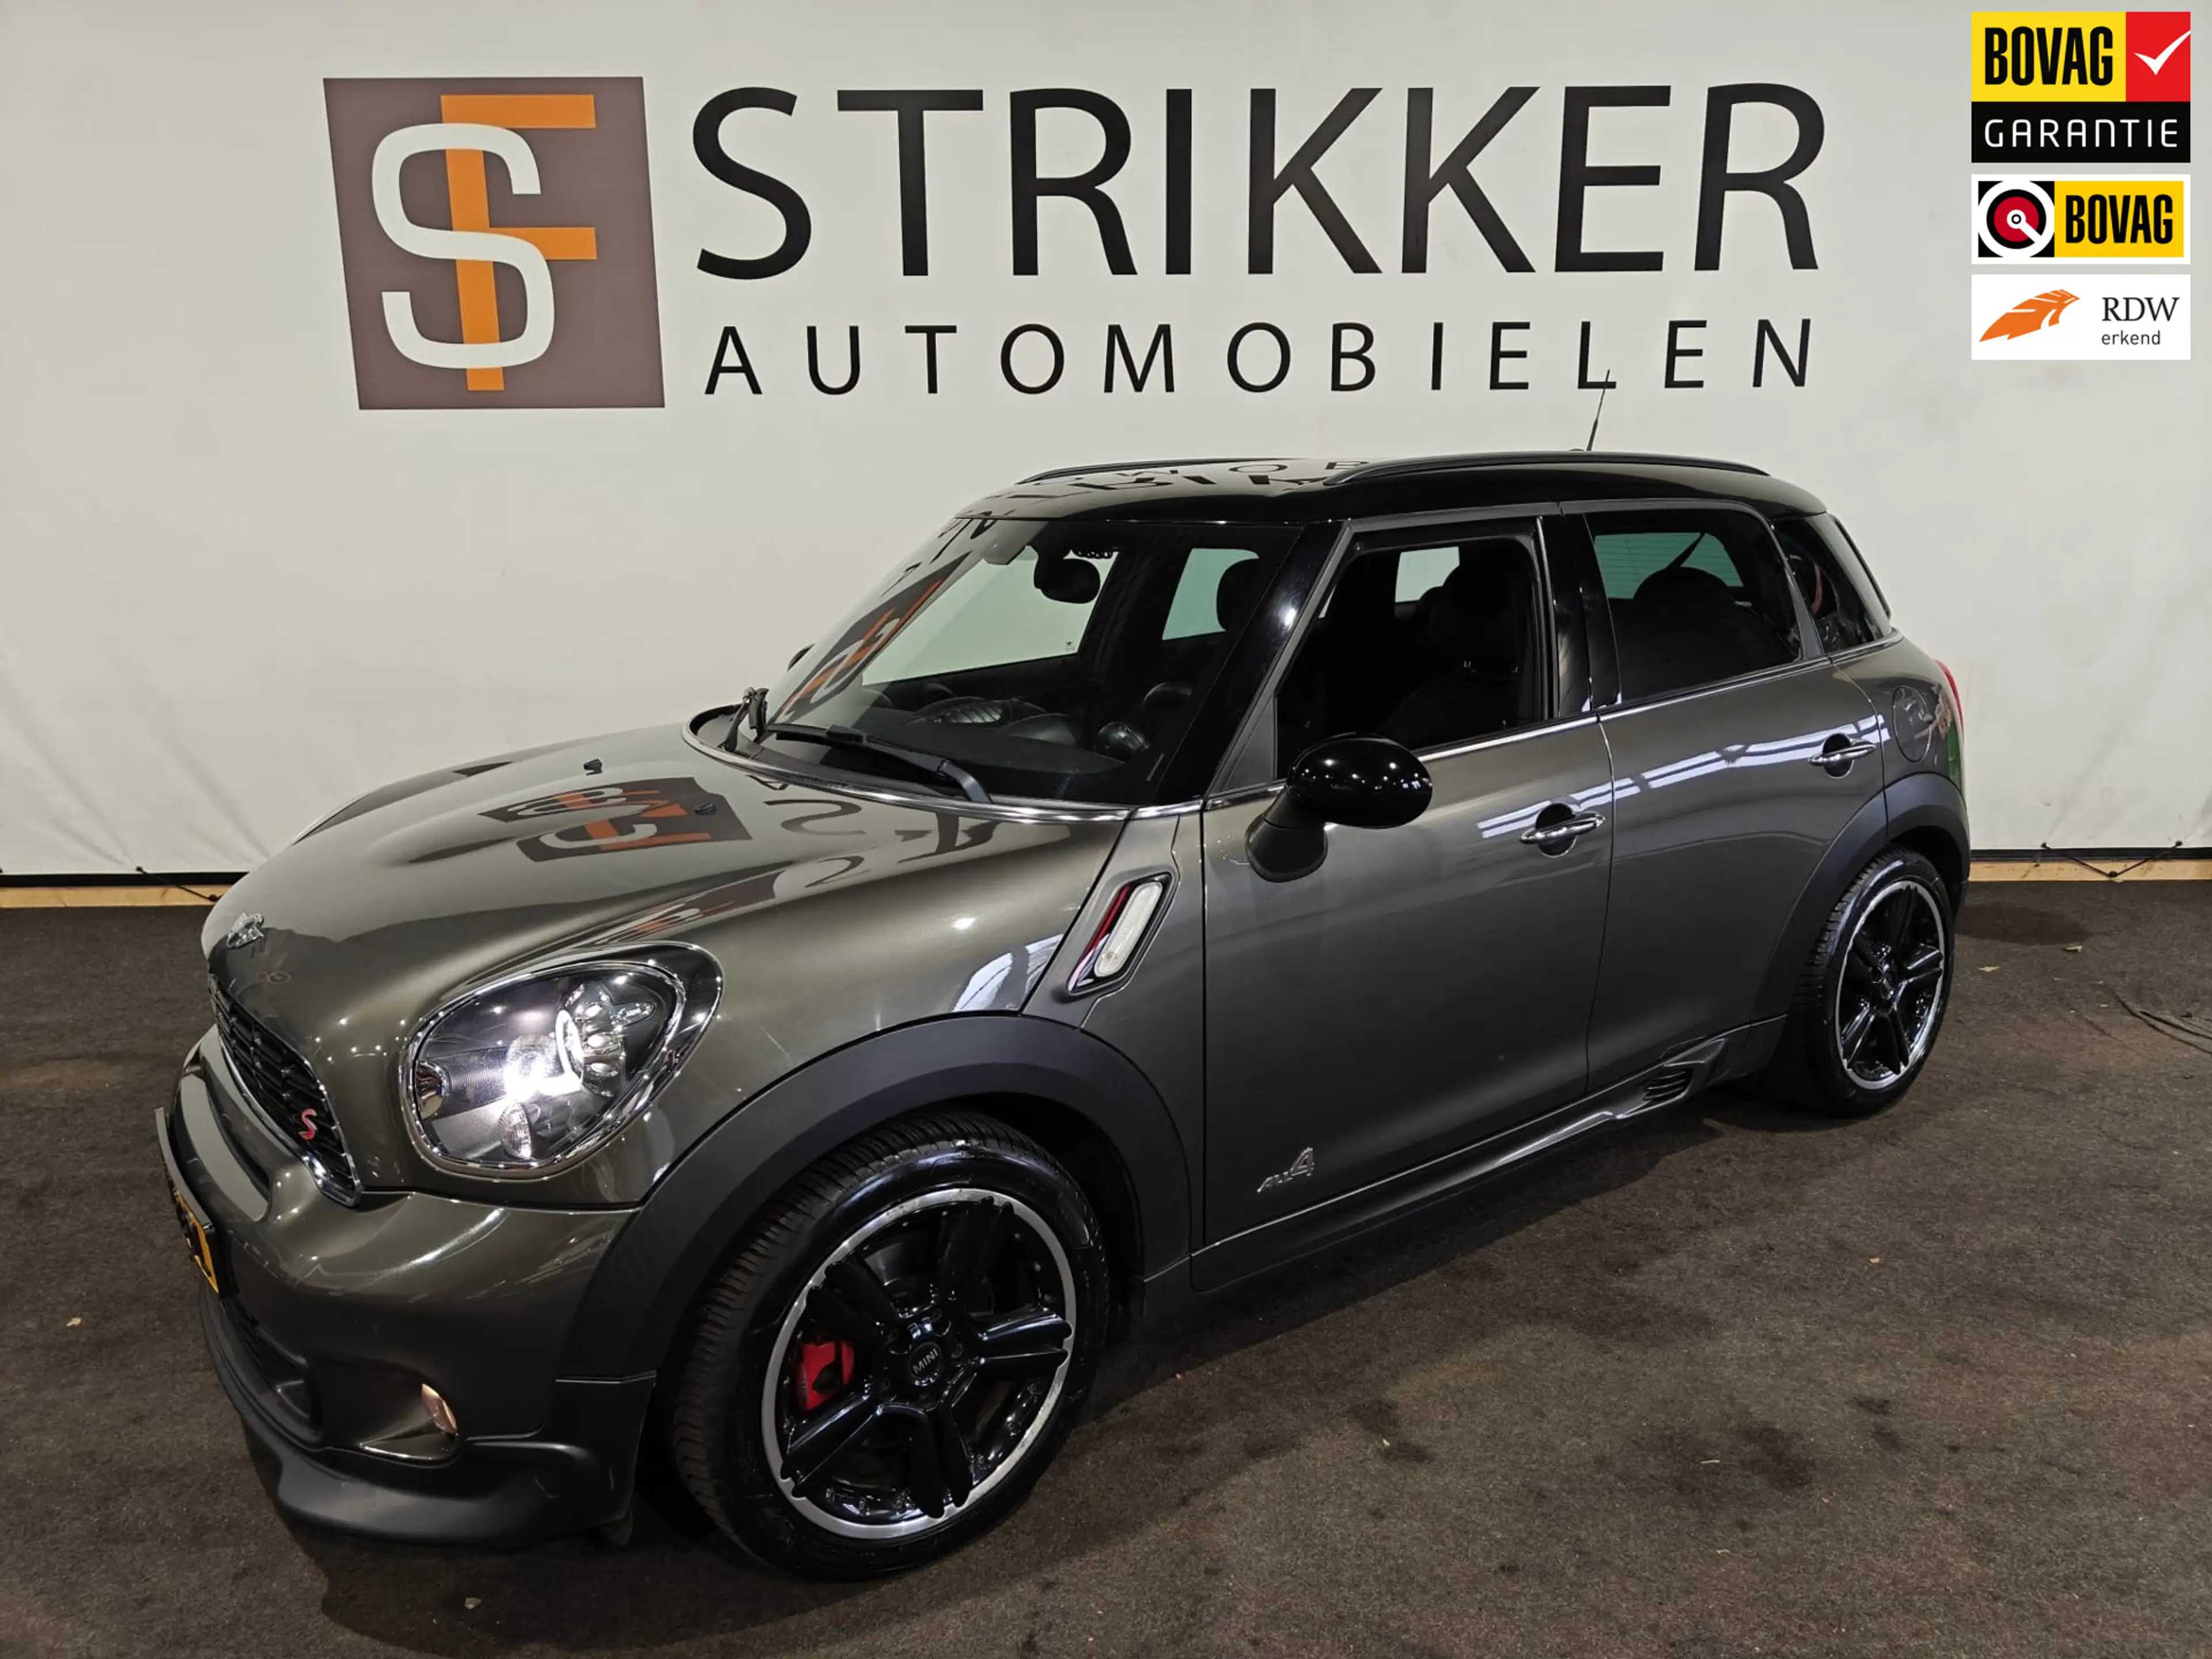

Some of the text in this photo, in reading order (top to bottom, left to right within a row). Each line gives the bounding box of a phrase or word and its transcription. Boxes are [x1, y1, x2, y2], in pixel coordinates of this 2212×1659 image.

[692, 83, 1824, 280] STRIKKER
[704, 319, 1811, 396] AUTOMOBIELEN
[298, 1108, 318, 1140] S
[912, 1348, 938, 1374] MINI
